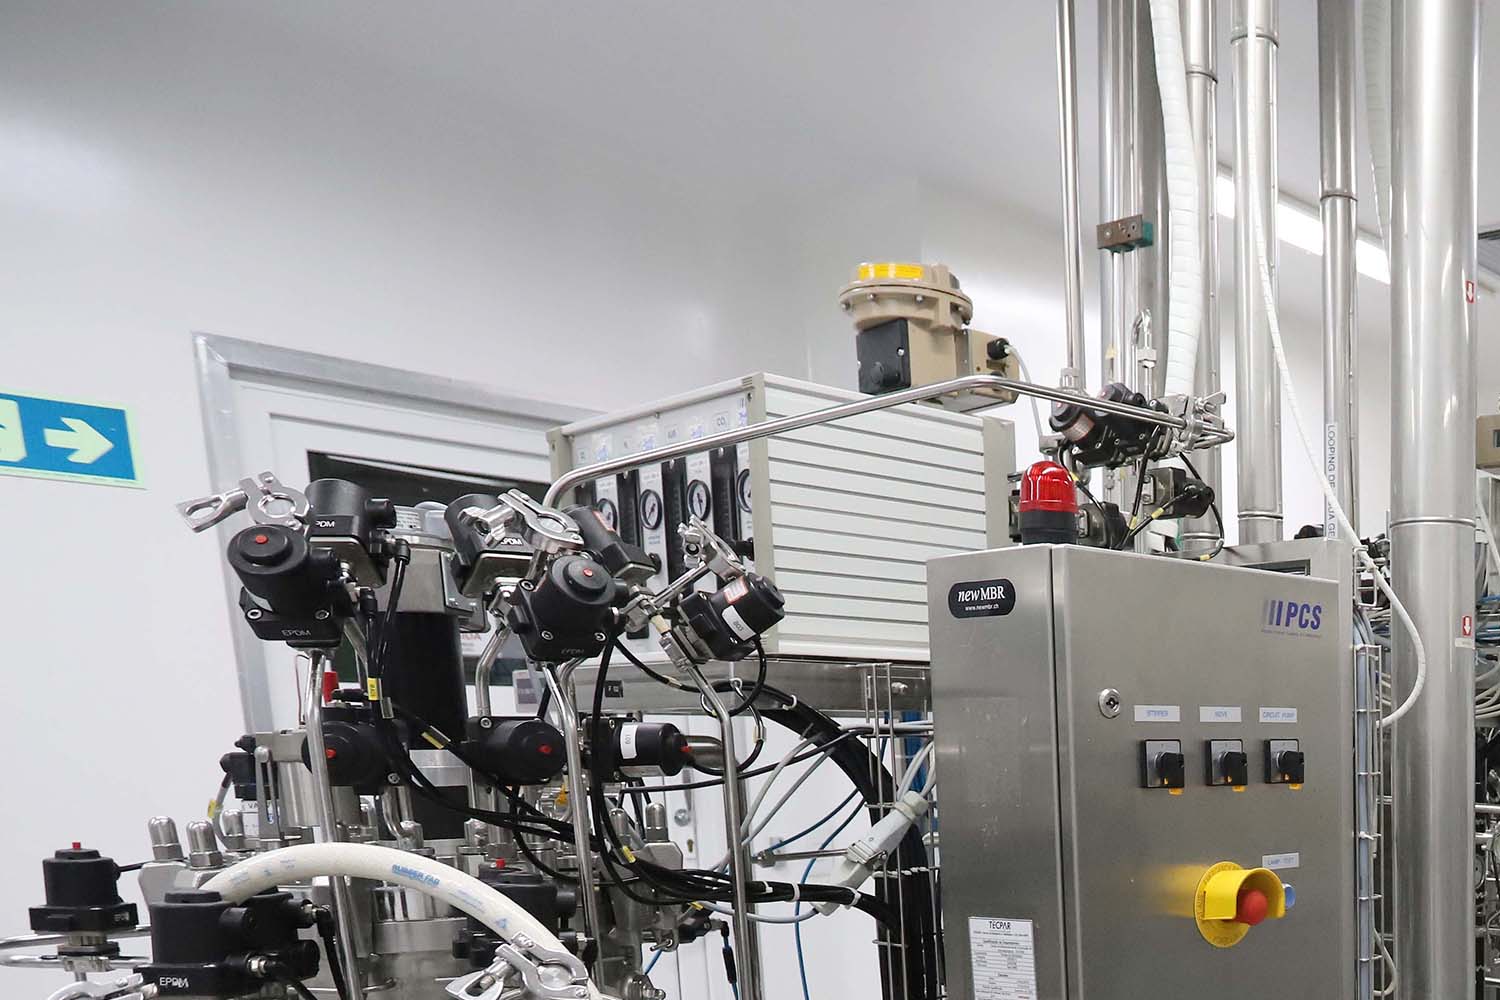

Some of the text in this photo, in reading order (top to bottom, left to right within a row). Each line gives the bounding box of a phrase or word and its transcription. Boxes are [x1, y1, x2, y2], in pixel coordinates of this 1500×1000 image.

[1327, 424, 1336, 472] LOOPING
[958, 585, 1006, 602] newMBR
[159, 976, 189, 988] EPDM
